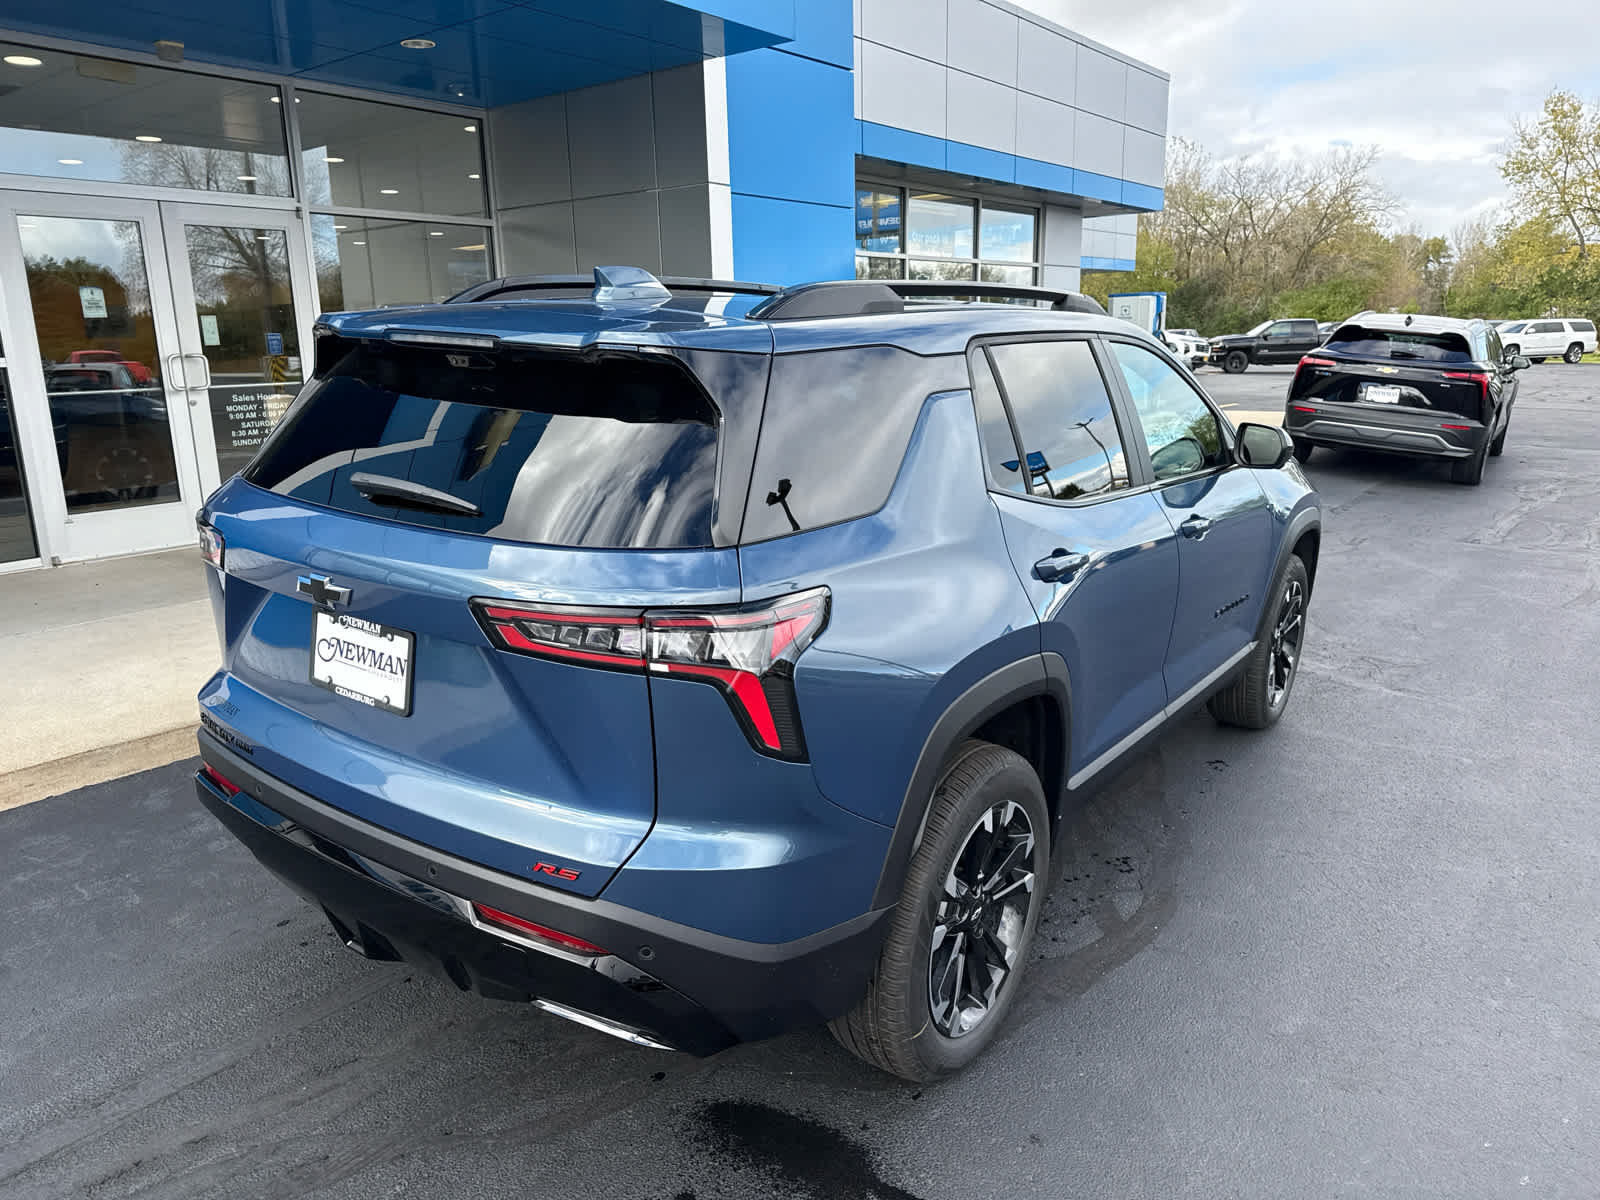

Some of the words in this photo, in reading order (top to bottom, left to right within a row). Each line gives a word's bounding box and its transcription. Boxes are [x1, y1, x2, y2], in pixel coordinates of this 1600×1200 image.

[232, 394, 255, 402] Sales
[226, 404, 258, 412] MONDAY
[263, 402, 289, 410] FRIDAY
[229, 412, 245, 420] 9:00
[232, 438, 262, 446] SUNDAY
[339, 615, 382, 633] NEWMAN
[317, 637, 408, 677] NEWMAN
[532, 862, 581, 881] RS
